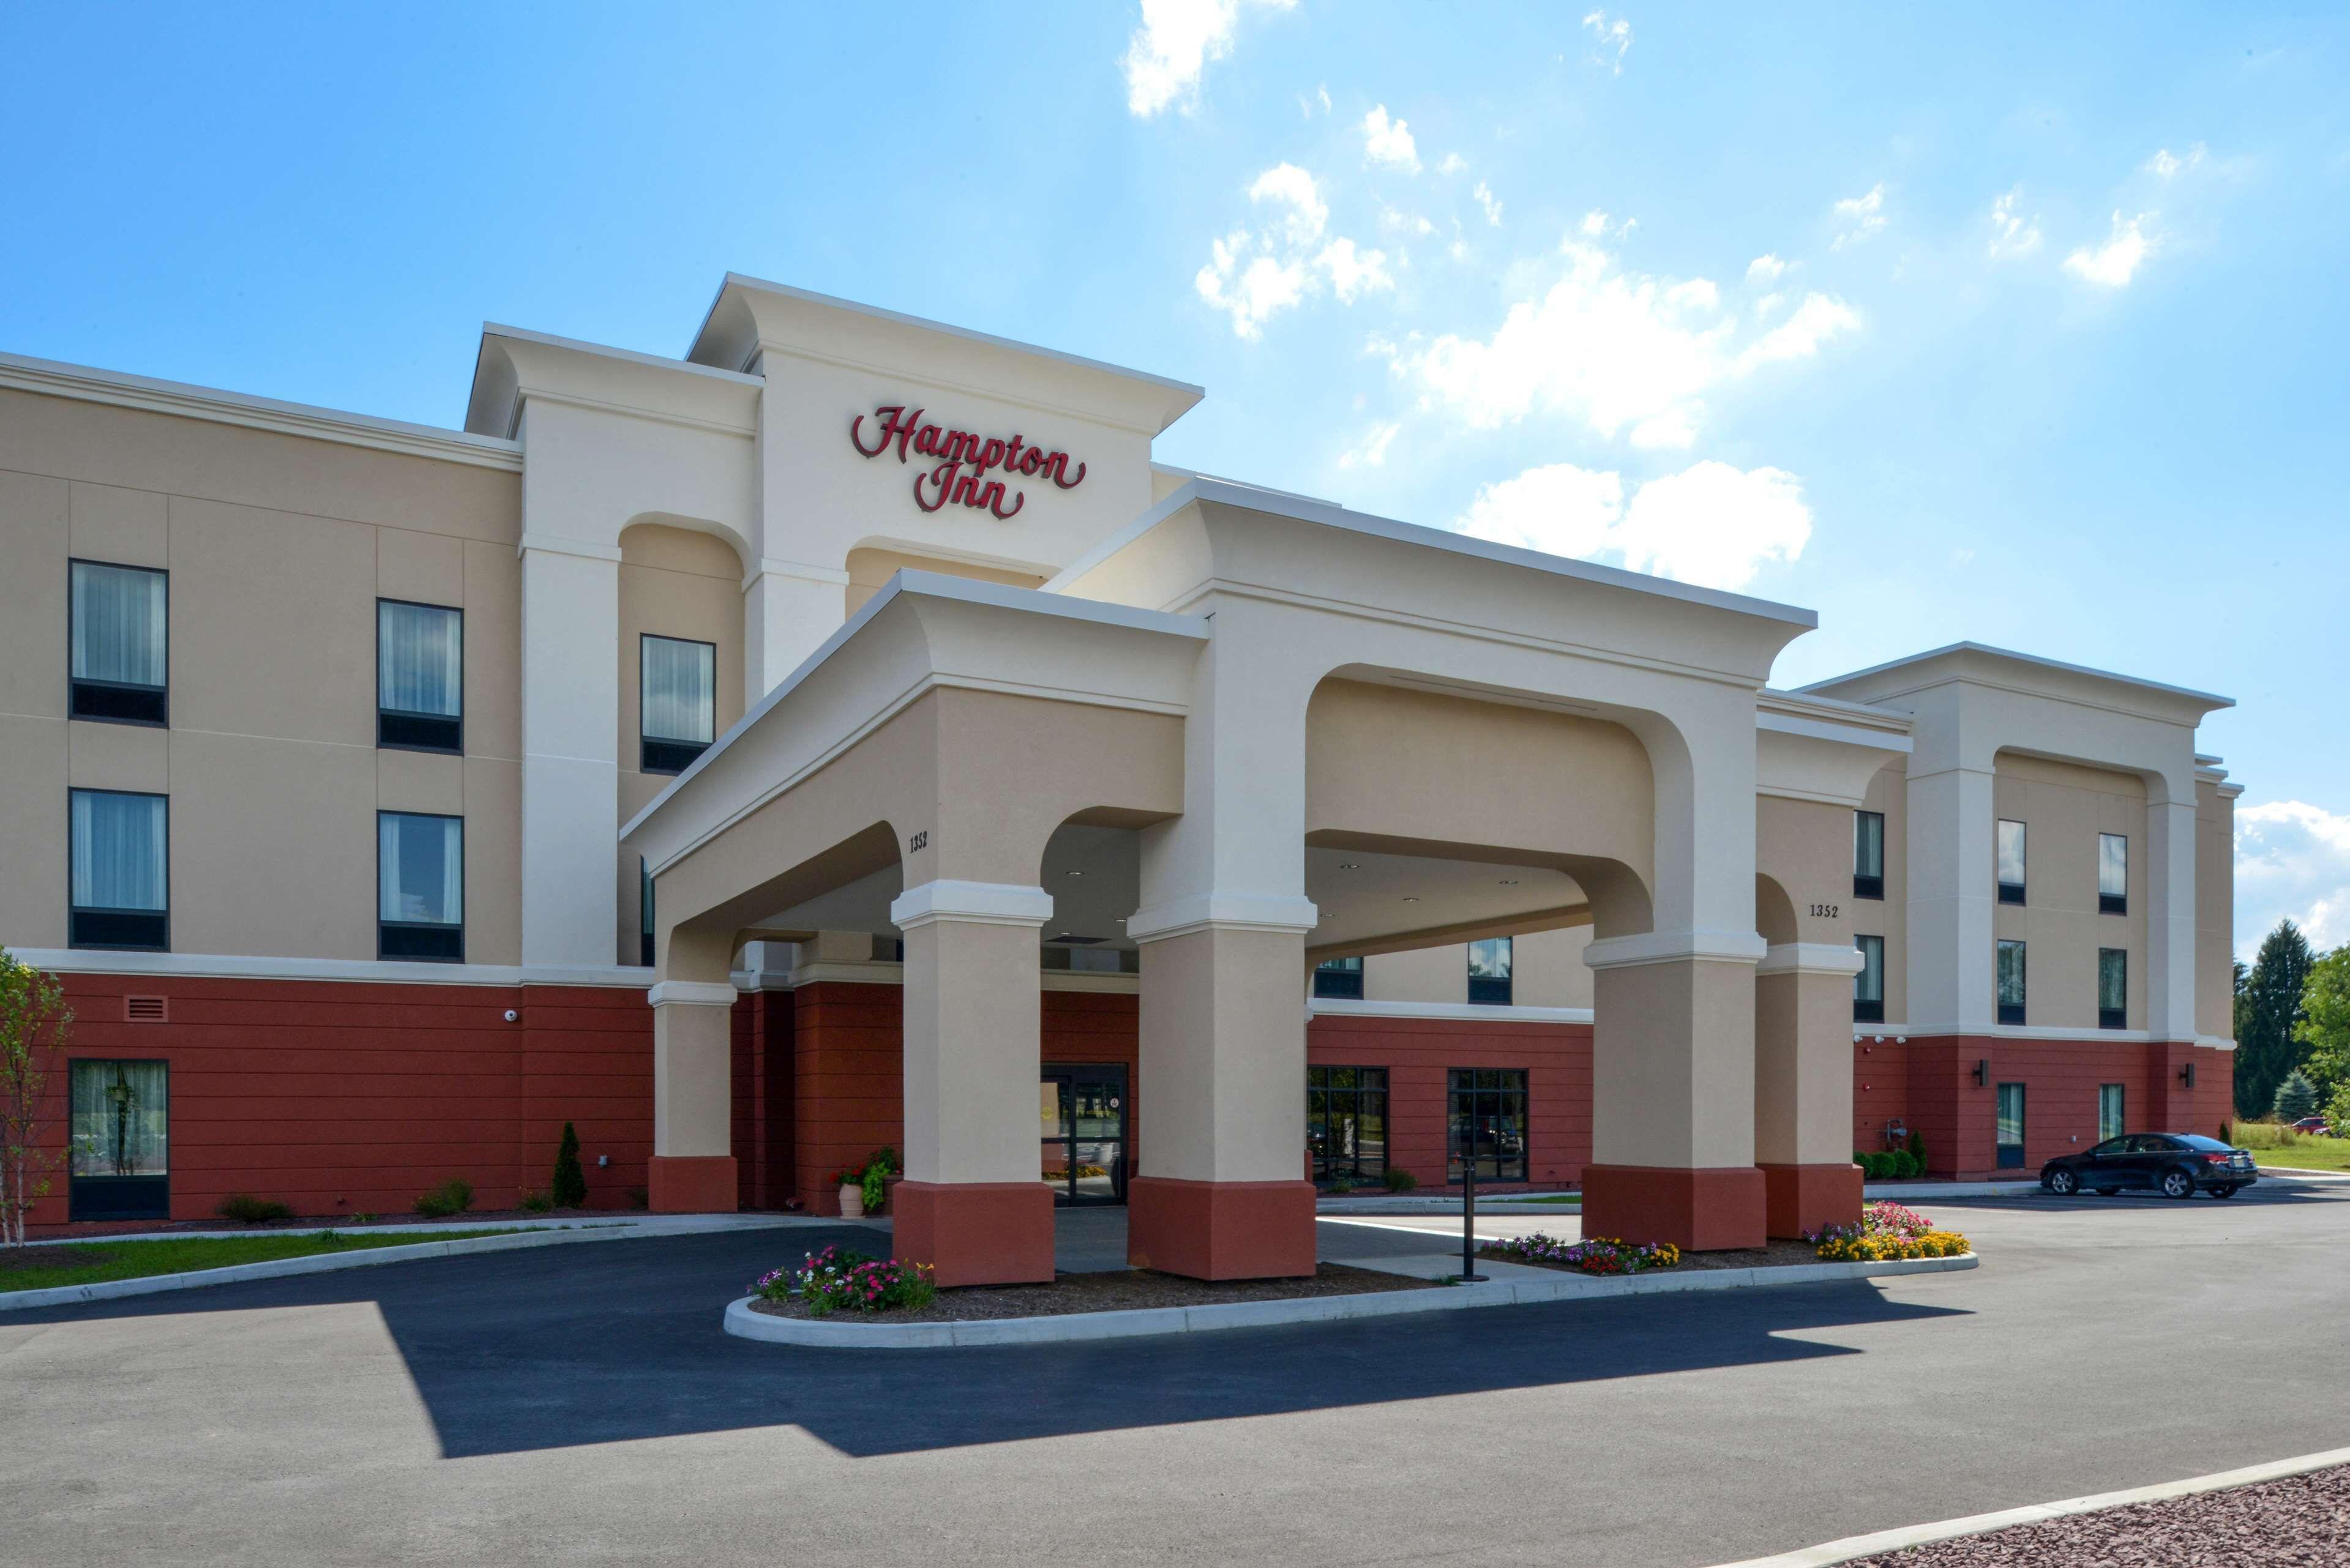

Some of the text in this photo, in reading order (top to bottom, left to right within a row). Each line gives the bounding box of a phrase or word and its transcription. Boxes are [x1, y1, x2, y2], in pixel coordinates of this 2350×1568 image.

[851, 406, 1087, 490] Hampton
[914, 461, 1024, 520] Inn
[910, 831, 927, 853] 1352
[1810, 904, 1838, 918] 1352
